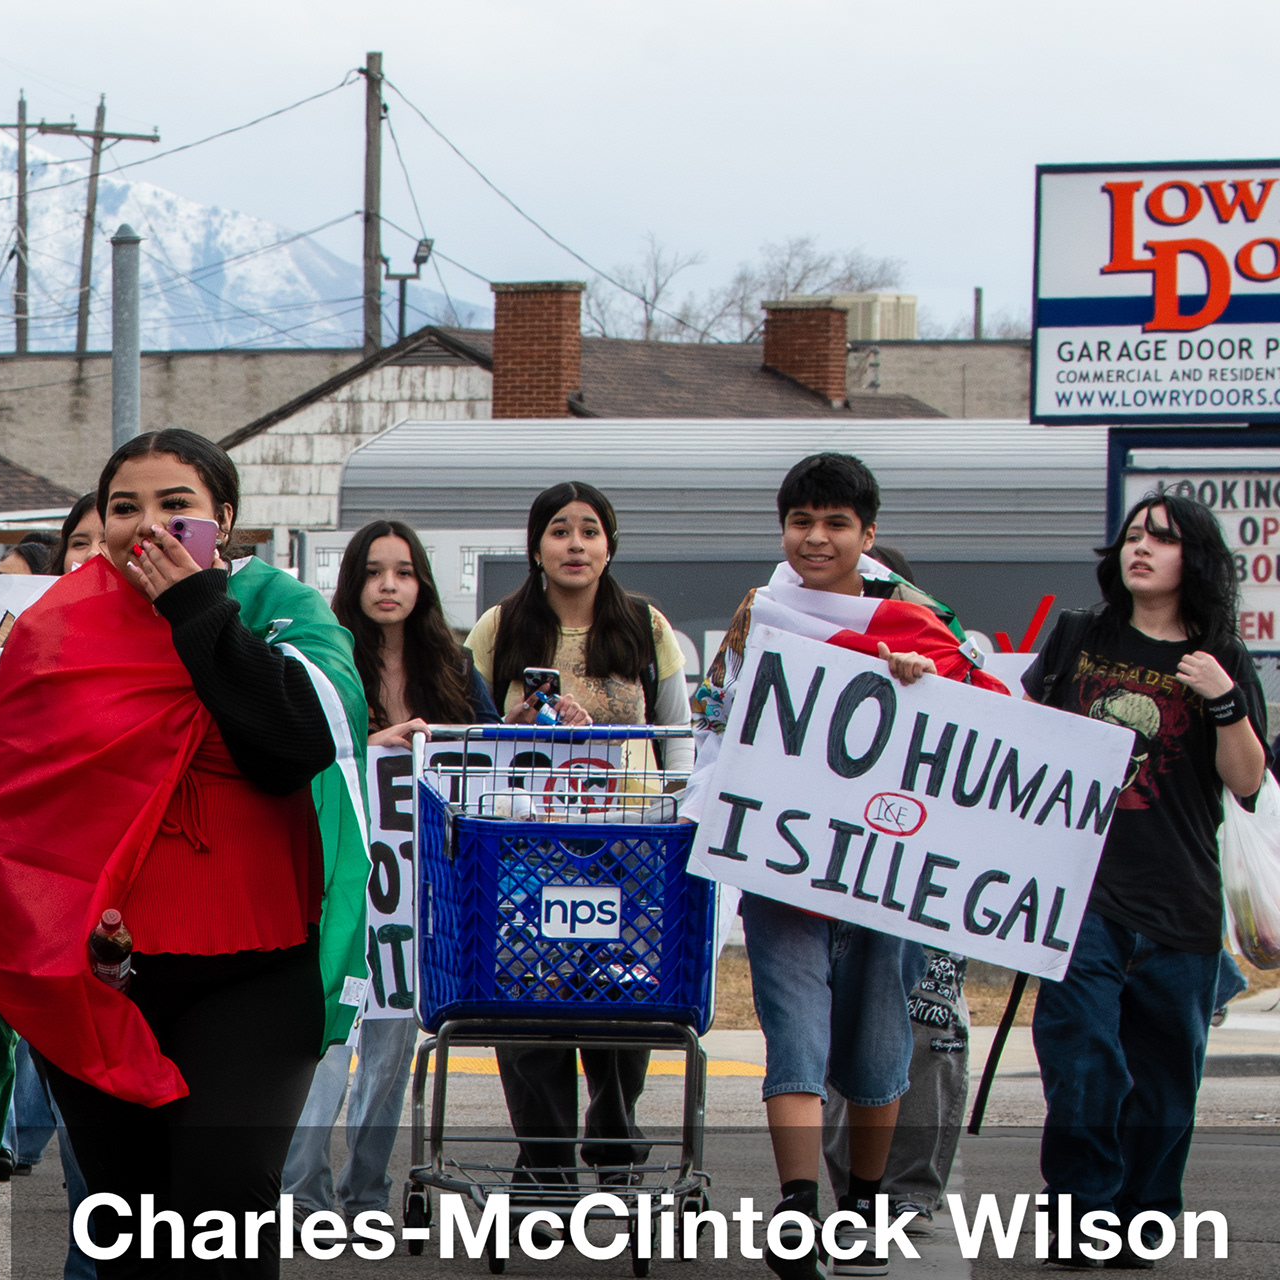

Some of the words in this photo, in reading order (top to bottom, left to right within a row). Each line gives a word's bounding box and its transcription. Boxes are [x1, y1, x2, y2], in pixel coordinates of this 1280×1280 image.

[1100, 179, 1280, 275] LOW
[1057, 340, 1168, 362] GARAGE
[1178, 338, 1255, 361] DOOR
[1056, 369, 1163, 384] COMMERCIAL
[1170, 368, 1203, 383] AND
[739, 650, 897, 779] NO
[900, 711, 1122, 836] HUMAN
[873, 797, 908, 827] ICE
[708, 792, 811, 875] IS
[811, 817, 1070, 952] ILLEGAL
[543, 898, 618, 933] nps
